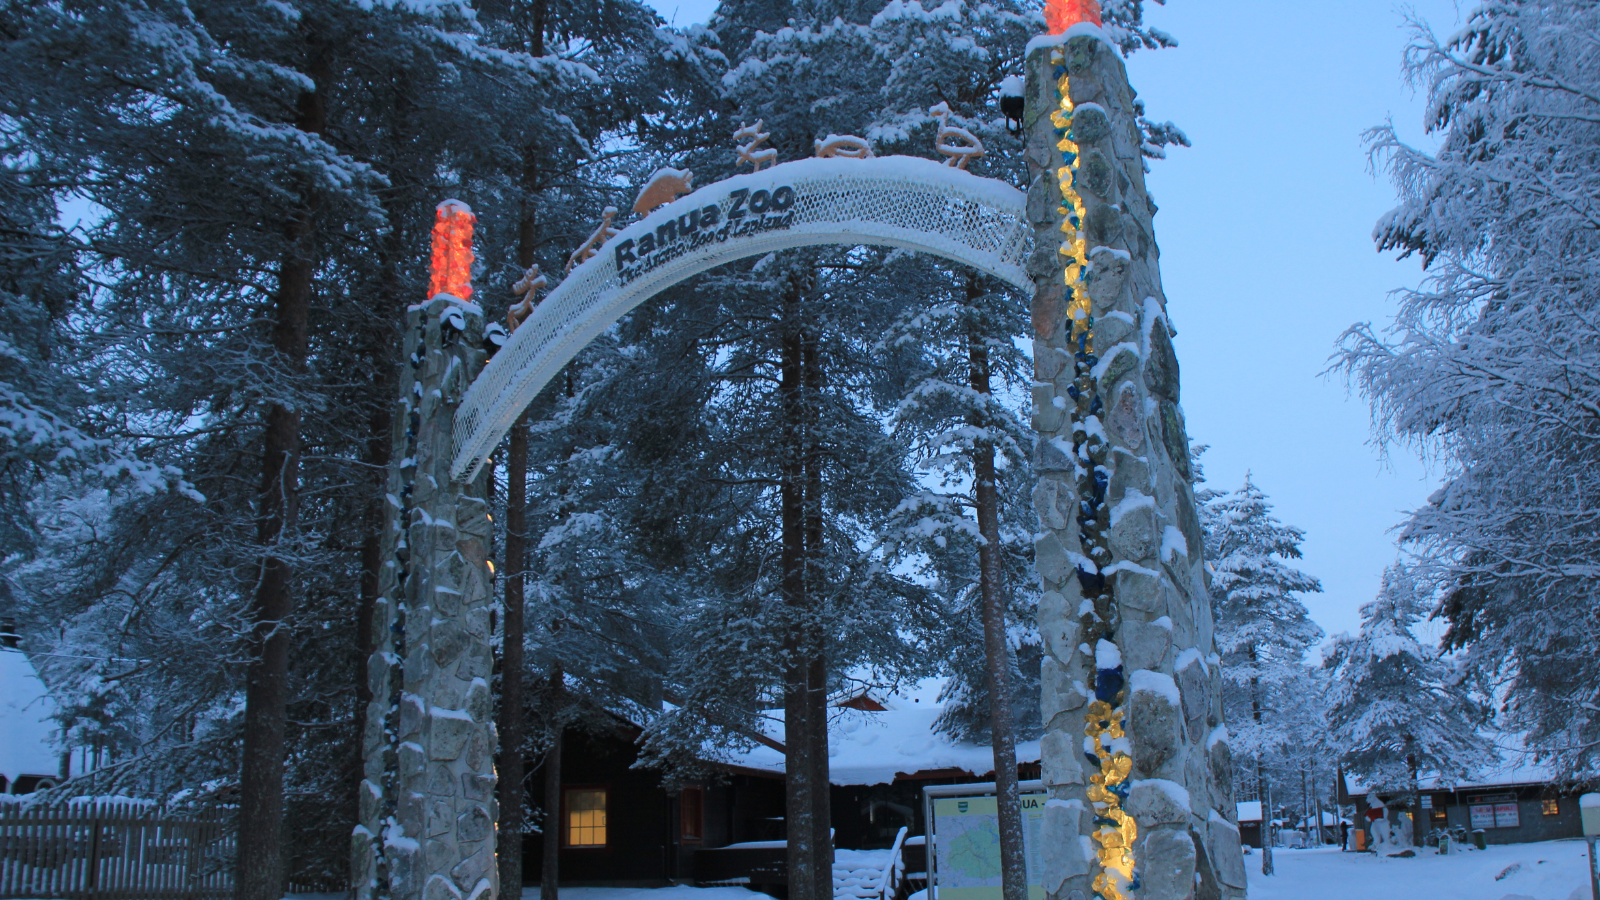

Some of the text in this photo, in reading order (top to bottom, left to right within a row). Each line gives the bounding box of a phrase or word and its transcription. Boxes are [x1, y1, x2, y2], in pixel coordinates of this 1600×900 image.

[615, 186, 795, 271] Ranua Zoo
[689, 229, 715, 249] Zoo
[716, 220, 732, 242] of
[731, 210, 794, 236] Lapland
